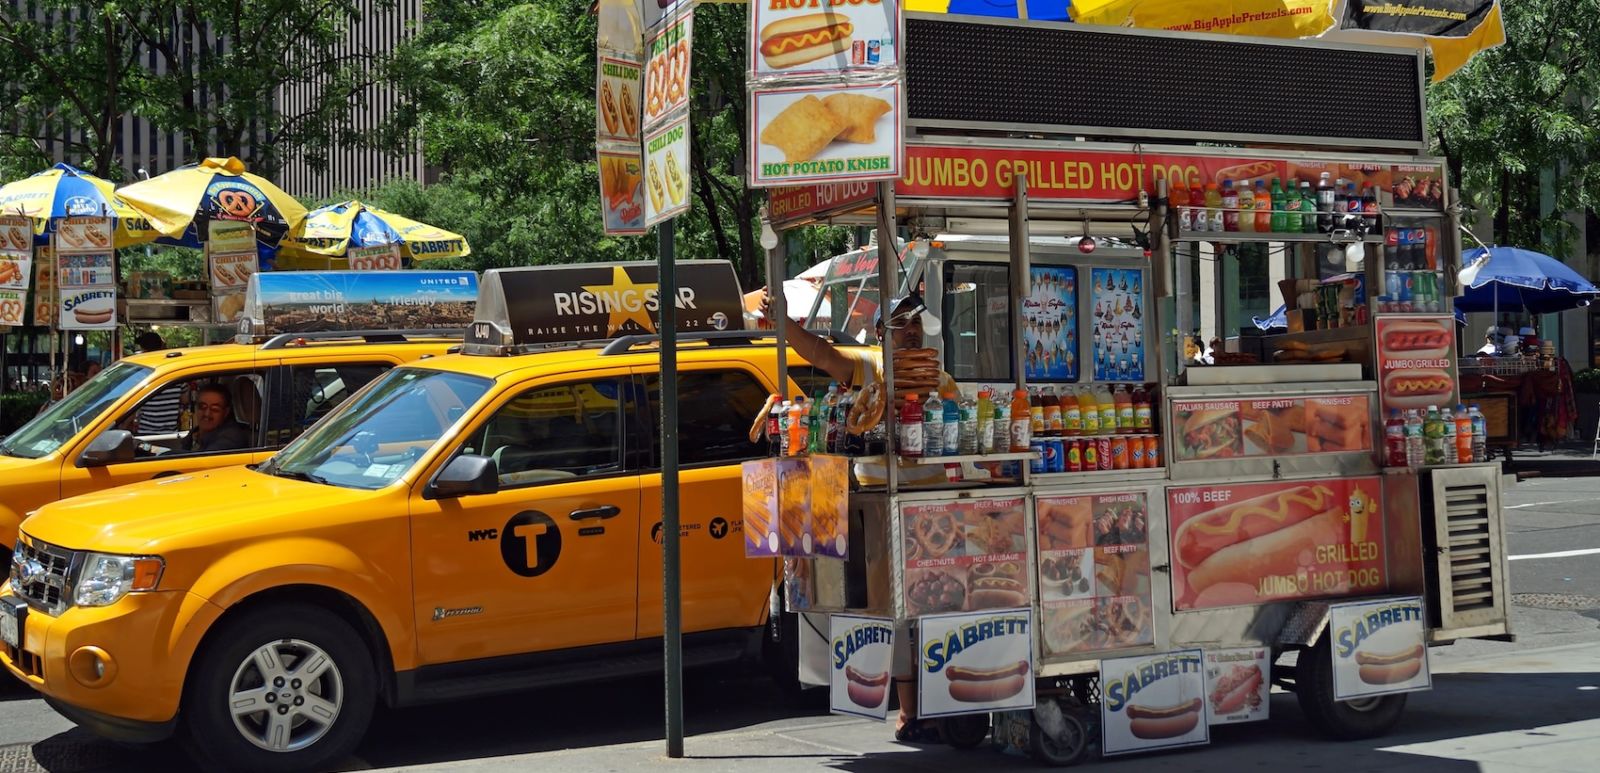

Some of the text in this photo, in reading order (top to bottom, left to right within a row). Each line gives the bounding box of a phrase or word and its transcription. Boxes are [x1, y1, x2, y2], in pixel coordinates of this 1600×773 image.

[602, 63, 639, 81] CHILI DOG
[648, 126, 684, 154] CHILI DOG
[763, 157, 890, 176] HOT POTATO KNISH
[903, 157, 1200, 192] JUMBO GRILLED HOT DOG
[772, 192, 812, 216] GRILLED
[816, 181, 869, 207] HOT DOG
[410, 240, 463, 255] SABRETT
[64, 291, 114, 311] SABRETT
[309, 303, 345, 314] world
[553, 287, 697, 316] RISING SAR
[528, 326, 567, 336] RAISE
[575, 324, 599, 333] THE
[607, 322, 640, 332] WALL
[686, 319, 699, 327] 22
[1384, 359, 1450, 369] JUMBO GRILLED
[1176, 402, 1240, 412] ITALIAN SAUSAGE
[1252, 400, 1294, 410] BEEF PATTY
[1172, 490, 1232, 504] 100% BEEF
[679, 523, 702, 531] ETERED
[468, 523, 547, 569] NYC T
[1103, 546, 1119, 554] BEEF
[1316, 542, 1378, 565] GRILLED
[917, 554, 1020, 567] CHESTNUTS HOT SAUSAGE
[1255, 568, 1380, 597] JUMBO HOT DOG
[1336, 603, 1422, 659] SABRETT
[832, 622, 893, 670] SABRETT
[923, 615, 1029, 673] SABRETT
[1105, 654, 1201, 713] SABRETT
